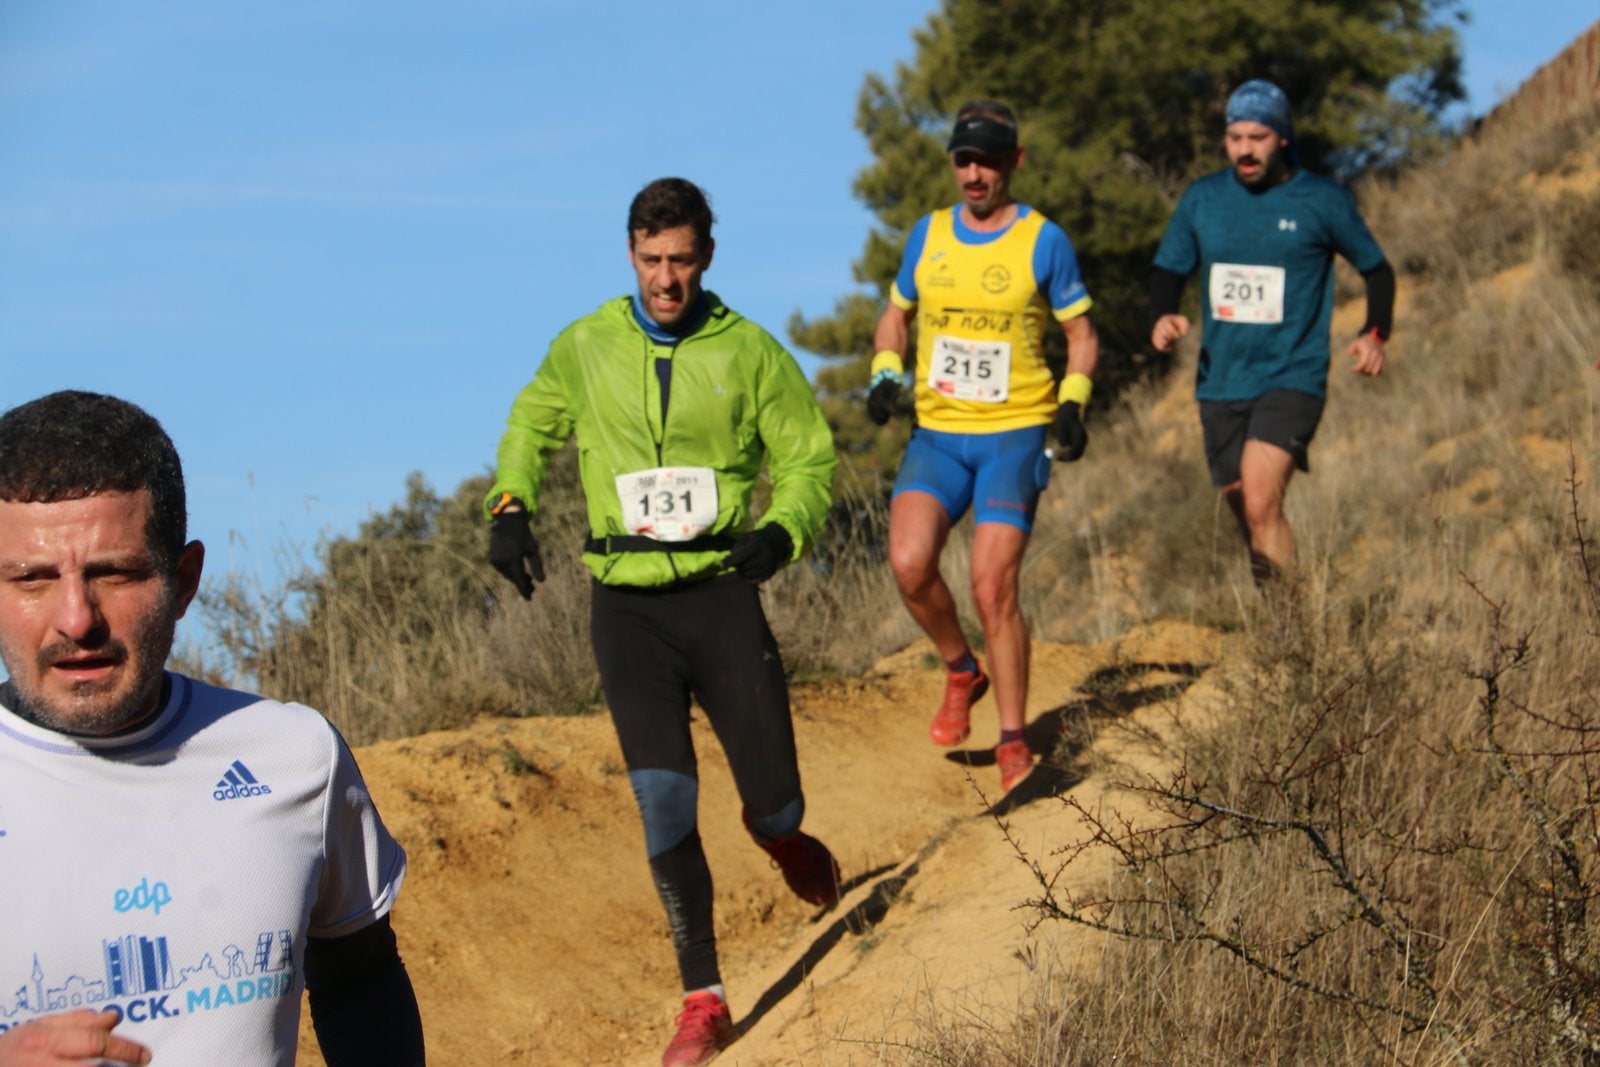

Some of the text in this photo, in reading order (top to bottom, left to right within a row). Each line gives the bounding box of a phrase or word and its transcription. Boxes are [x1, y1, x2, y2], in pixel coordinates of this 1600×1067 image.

[1223, 282, 1264, 301] 201
[943, 356, 992, 379] 215
[639, 490, 692, 516] 131
[213, 783, 272, 801] adidas
[113, 877, 172, 915] edp
[98, 972, 293, 1027] OCK. MADRID
